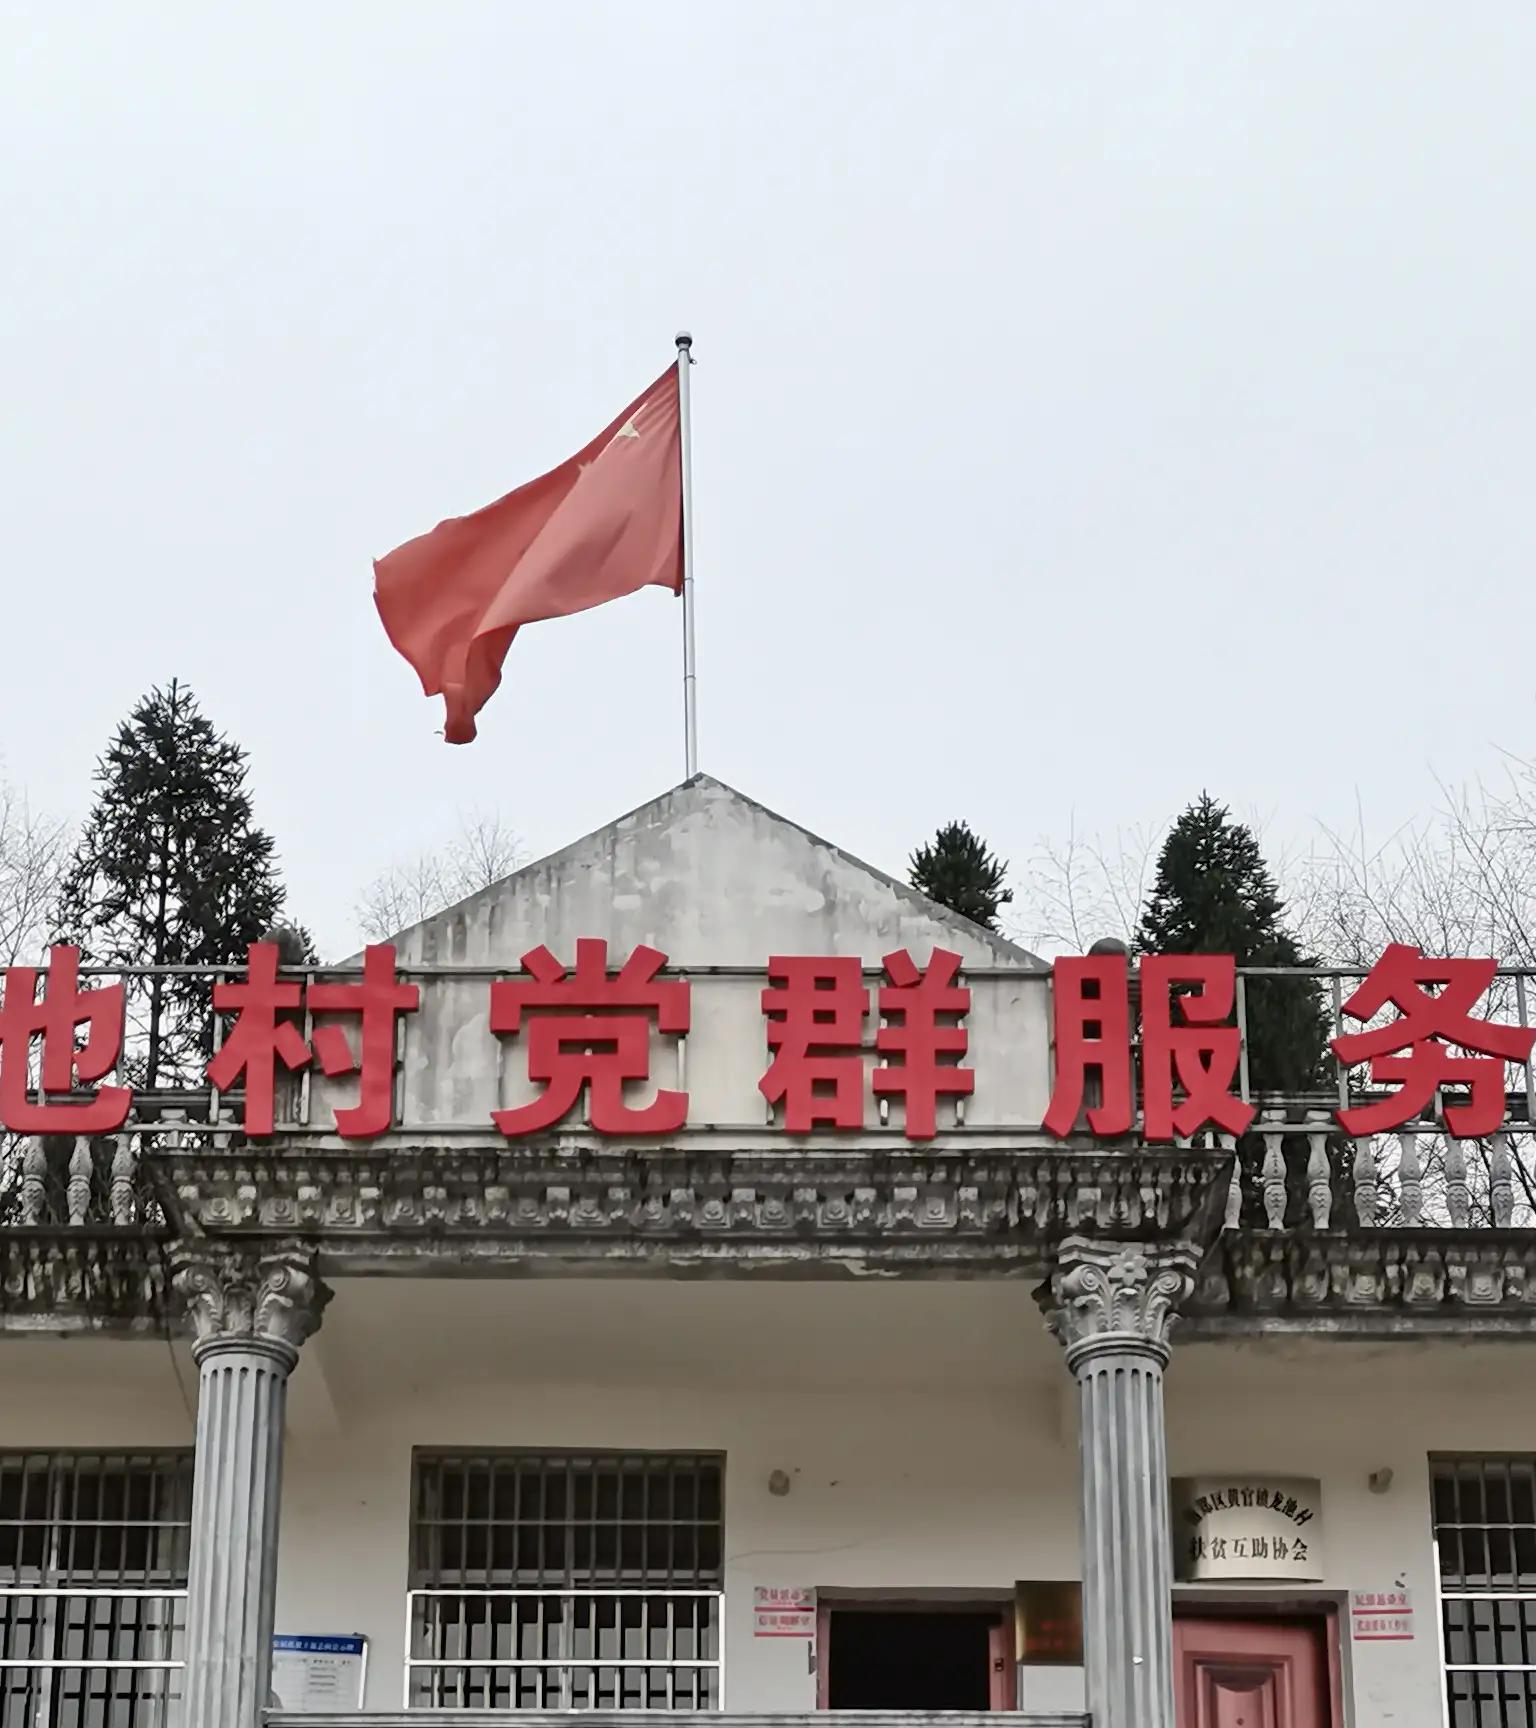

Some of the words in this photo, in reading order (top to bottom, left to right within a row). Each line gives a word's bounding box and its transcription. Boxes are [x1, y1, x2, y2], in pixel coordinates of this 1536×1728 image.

[1191, 1535, 1309, 1562] 扶贫互助协会
